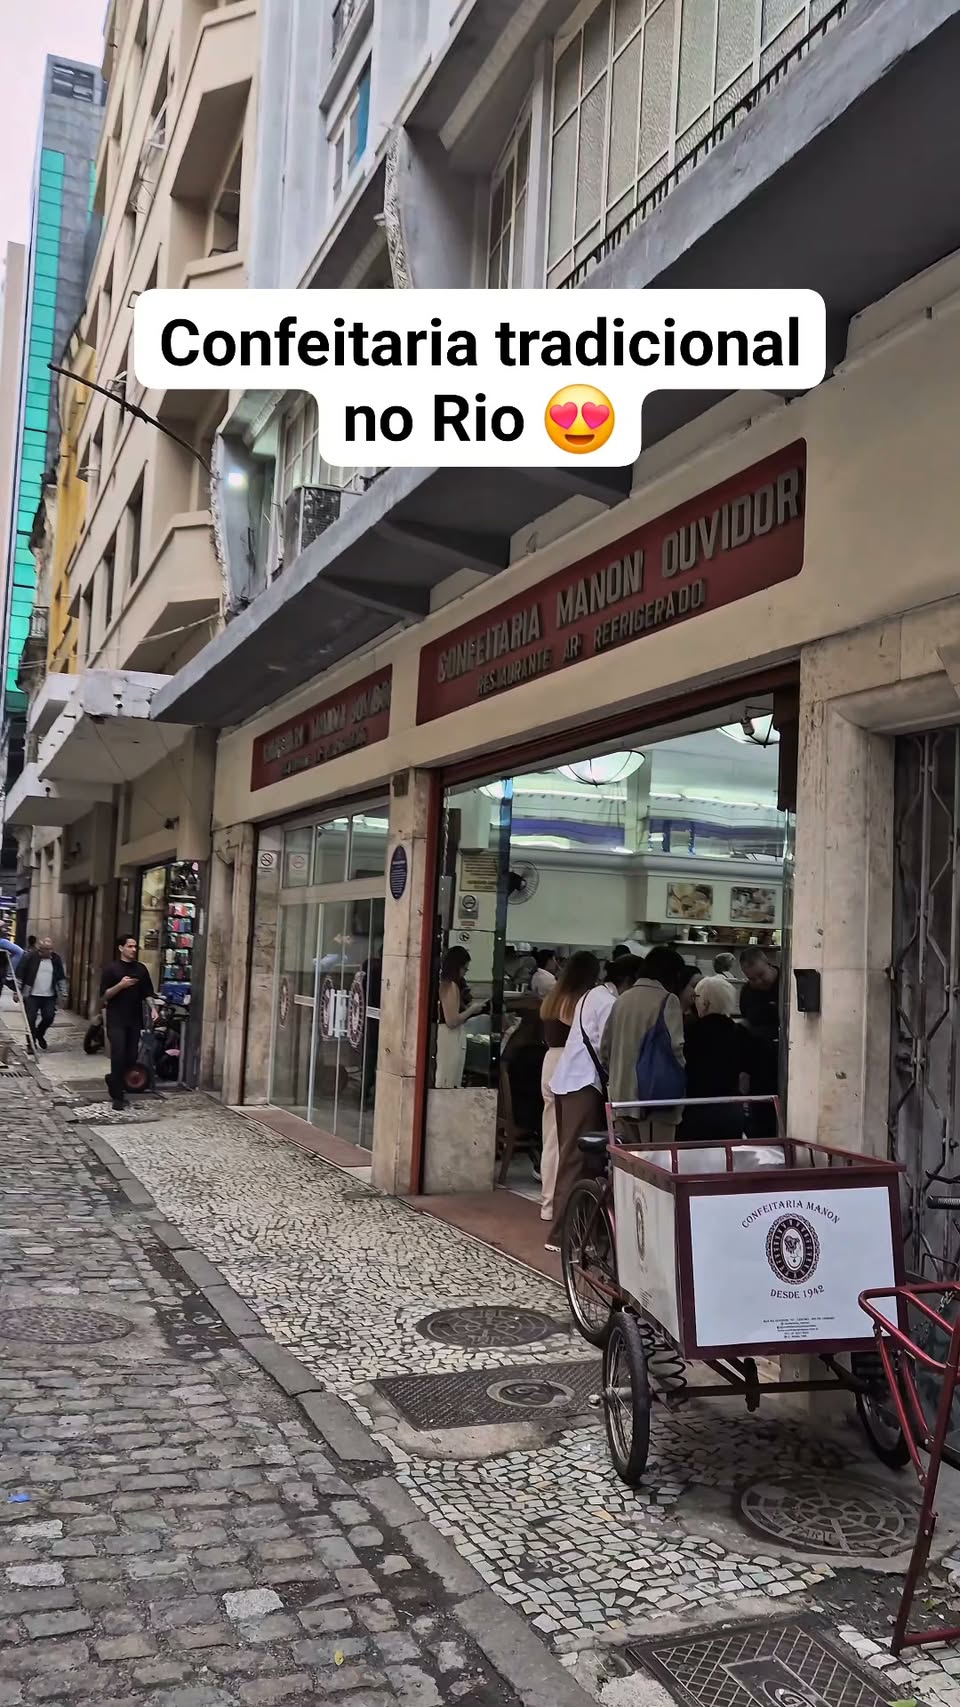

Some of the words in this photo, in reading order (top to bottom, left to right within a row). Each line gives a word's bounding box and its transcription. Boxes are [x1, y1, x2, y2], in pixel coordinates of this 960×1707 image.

[437, 603, 541, 684] CONFEITARIA
[556, 549, 644, 630] MANON
[661, 467, 800, 579] OUVIDOR
[593, 578, 706, 649] REFRIGERADO
[741, 1199, 804, 1228] CONFEITARIA
[806, 1201, 840, 1224] MANON
[770, 1288, 801, 1299] DESDE
[803, 1284, 825, 1298] 1942
